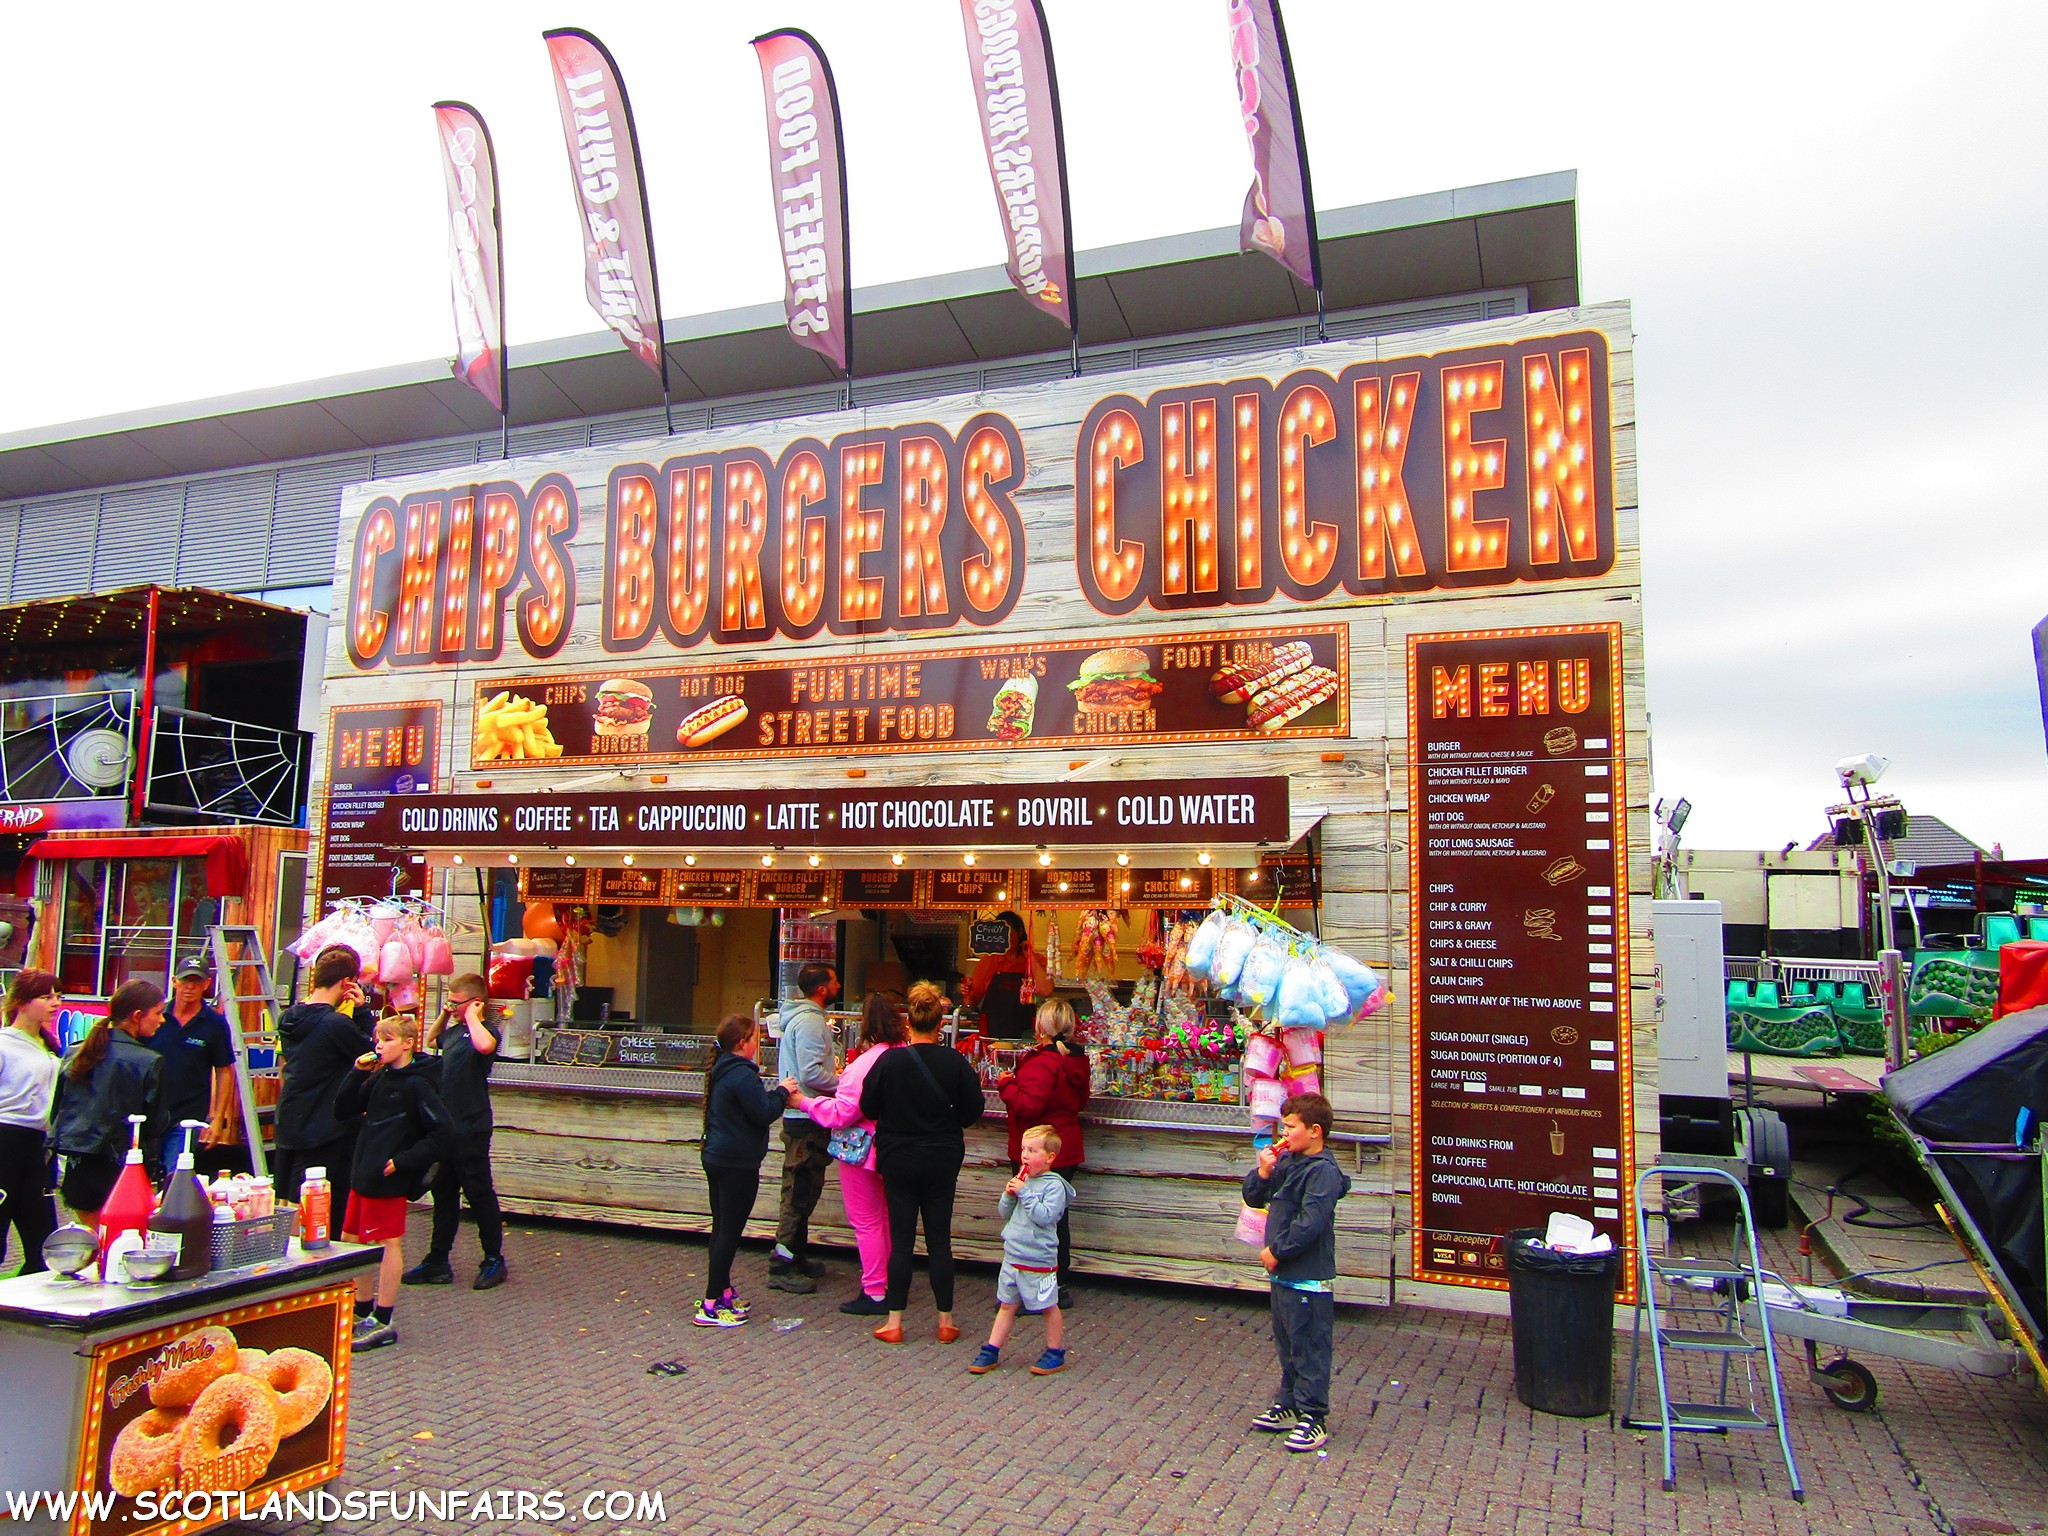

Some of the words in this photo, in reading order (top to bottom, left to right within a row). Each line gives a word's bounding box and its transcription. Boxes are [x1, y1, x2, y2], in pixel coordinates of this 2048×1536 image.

[355, 483, 569, 661] CHIPS
[611, 425, 1014, 641] BURGERS
[1090, 347, 1598, 601] CHICKEN
[1162, 644, 1215, 670] FOOT
[1219, 640, 1276, 667] LONG
[978, 655, 1048, 680] WRAPS
[680, 677, 710, 697] HOT
[714, 676, 745, 694] DOG
[790, 663, 922, 704] FUNTIME
[1432, 659, 1590, 718] MENU
[546, 685, 586, 705] CHIPS
[759, 707, 870, 746] STREET
[879, 704, 956, 741] FOOD
[1073, 708, 1156, 734] CHICKEN
[339, 726, 424, 768] MENU
[591, 734, 648, 754] BURGER
[1428, 742, 1460, 751] BURGER
[1428, 767, 1463, 777] CHICKEN
[1465, 767, 1491, 776] FILLET
[1494, 766, 1527, 775] BURGER
[1428, 795, 1463, 803] CHICKEN
[1465, 794, 1490, 802] WRAP
[402, 809, 438, 832] COLD
[442, 807, 498, 832] DRINKS
[515, 806, 571, 831] COFFEE
[589, 806, 619, 830] TEA
[638, 804, 746, 831] CAPPUCCINO
[767, 803, 819, 830] LATTE
[841, 802, 878, 829] HOT
[882, 799, 993, 828] CHOCOLATE
[1018, 798, 1092, 826] BOVRIL
[1117, 795, 1173, 825] COLD
[1179, 795, 1255, 824] WATER
[1429, 813, 1445, 821] HOT
[1447, 812, 1464, 821] DOG
[1429, 839, 1450, 848] FOOT
[1452, 839, 1473, 848] LONG
[1475, 839, 1513, 848] SAUSAGE
[680, 872, 710, 882] CHICKEN
[713, 872, 740, 882] WRAPS
[760, 873, 793, 882] CHICKEN
[796, 872, 824, 882] FILLET
[861, 873, 898, 883] BURGERS
[941, 873, 962, 883] SALT
[973, 873, 1002, 883] CHILLI
[1047, 871, 1064, 882] HOT
[1066, 871, 1091, 882] DOGS
[1162, 870, 1181, 880] HOT
[776, 883, 806, 893] BURGER
[958, 884, 983, 894] CHIPS
[1429, 884, 1454, 893] CHIPS
[1429, 902, 1448, 911] CHIP
[1451, 903, 1457, 911] &
[1459, 903, 1487, 911] CURRY
[976, 924, 1004, 933] CANDY
[1430, 921, 1454, 930] CHIPS
[1464, 922, 1492, 930] GRAVY
[975, 934, 1005, 943] FLOSS
[1430, 939, 1454, 948] CHIPS
[1456, 940, 1462, 948] &
[1465, 940, 1497, 949] CHEESE
[1430, 958, 1449, 966] SALT
[1451, 958, 1457, 967] &
[1460, 959, 1485, 967] CHILLI
[1488, 959, 1513, 968] CHIPS
[1430, 976, 1456, 986] CAJUN
[1458, 977, 1484, 986] CHIPS
[1430, 995, 1454, 1004] CHIPS
[1457, 996, 1479, 1005] WITH
[1481, 997, 1498, 1006] ANY
[1500, 997, 1510, 1006] OF
[1512, 998, 1529, 1007] THE
[1531, 999, 1551, 1008] TWO
[1553, 999, 1581, 1009] ABOVE
[620, 1037, 656, 1049] CHEESE
[666, 1039, 701, 1049] CHICKEN
[1430, 1032, 1459, 1041] SUGAR
[1461, 1033, 1489, 1043] DONUT
[1491, 1034, 1529, 1046] (SINGLE)
[619, 1050, 658, 1064] BURGER
[1430, 1051, 1459, 1061] SUGAR
[1461, 1052, 1495, 1062] DONUTS
[1497, 1053, 1537, 1064] (PORTION
[1540, 1056, 1551, 1065] OF
[1553, 1056, 1562, 1067] 4)
[1431, 1069, 1458, 1080] CANDY
[1461, 1071, 1487, 1081] FLOSS
[1489, 1085, 1505, 1093] SMALL
[1431, 1101, 1461, 1109] SELECTION
[1471, 1103, 1493, 1111] SWEETS
[1500, 1105, 1546, 1114] CONFECTIONERY
[1555, 1108, 1579, 1116] VARIOUS
[1581, 1109, 1602, 1118] PRICES
[1432, 1136, 1453, 1146] COLD
[1456, 1138, 1487, 1149] DRINKS
[1489, 1139, 1513, 1150] FROM
[1432, 1155, 1448, 1165] TEA
[1449, 1156, 1453, 1165] /
[1456, 1157, 1487, 1168] COFFEE
[1432, 1174, 1487, 1189] CAPPUCCINO,
[1489, 1178, 1516, 1190] LATTE,
[1518, 1181, 1534, 1191] HOT
[1537, 1182, 1587, 1195] CHOCOLATE
[1432, 1193, 1462, 1204] BOVRIL
[1432, 1232, 1451, 1241] Cash
[1453, 1235, 1490, 1245] accepted
[109, 1357, 163, 1408] Freshly
[163, 1337, 215, 1370] Made
